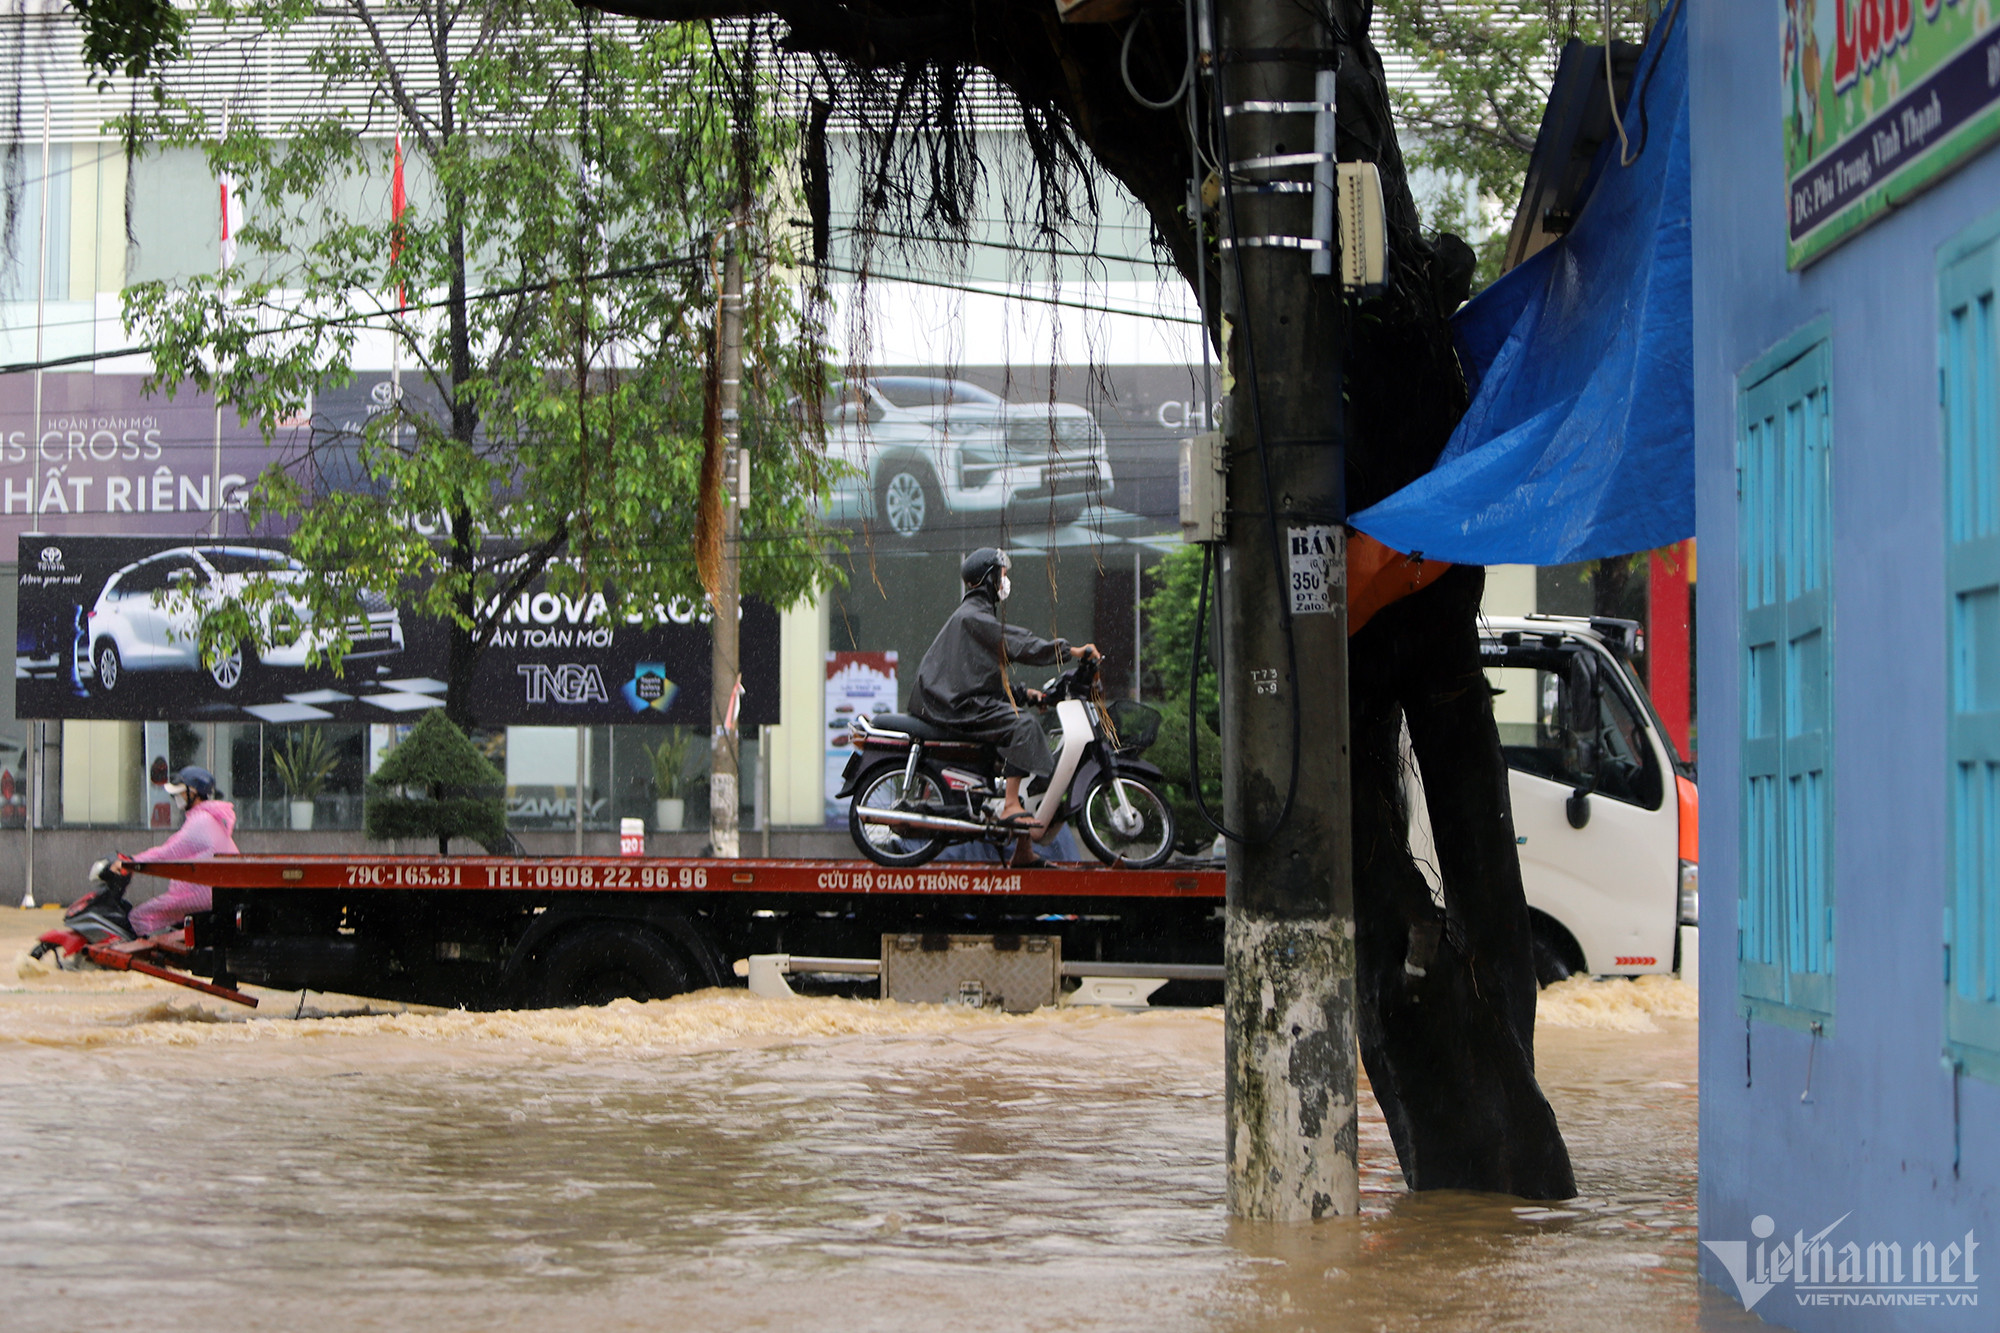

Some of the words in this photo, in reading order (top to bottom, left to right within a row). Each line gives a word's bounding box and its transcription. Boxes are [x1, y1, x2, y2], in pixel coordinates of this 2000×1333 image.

[48, 416, 88, 430] HOÀN
[91, 416, 127, 430] TOÀN
[131, 416, 158, 429] MỚI
[1159, 401, 1221, 428] CH
[40, 430, 162, 461] CROSS
[4, 465, 93, 514] HẤT
[107, 465, 249, 513] RIÊNG
[1292, 530, 1336, 555] BÁN
[1296, 602, 1325, 611] Zalo:
[522, 627, 573, 648] TOÀN
[576, 626, 614, 648] MỚI
[517, 664, 609, 704] TNGA
[506, 798, 608, 817] CAMRY
[346, 866, 462, 885] 79C-165.31
[852, 871, 874, 893] HỘ
[876, 874, 914, 890] GIAO
[917, 872, 969, 891] THÔNG
[972, 874, 1021, 893] 24/24H
